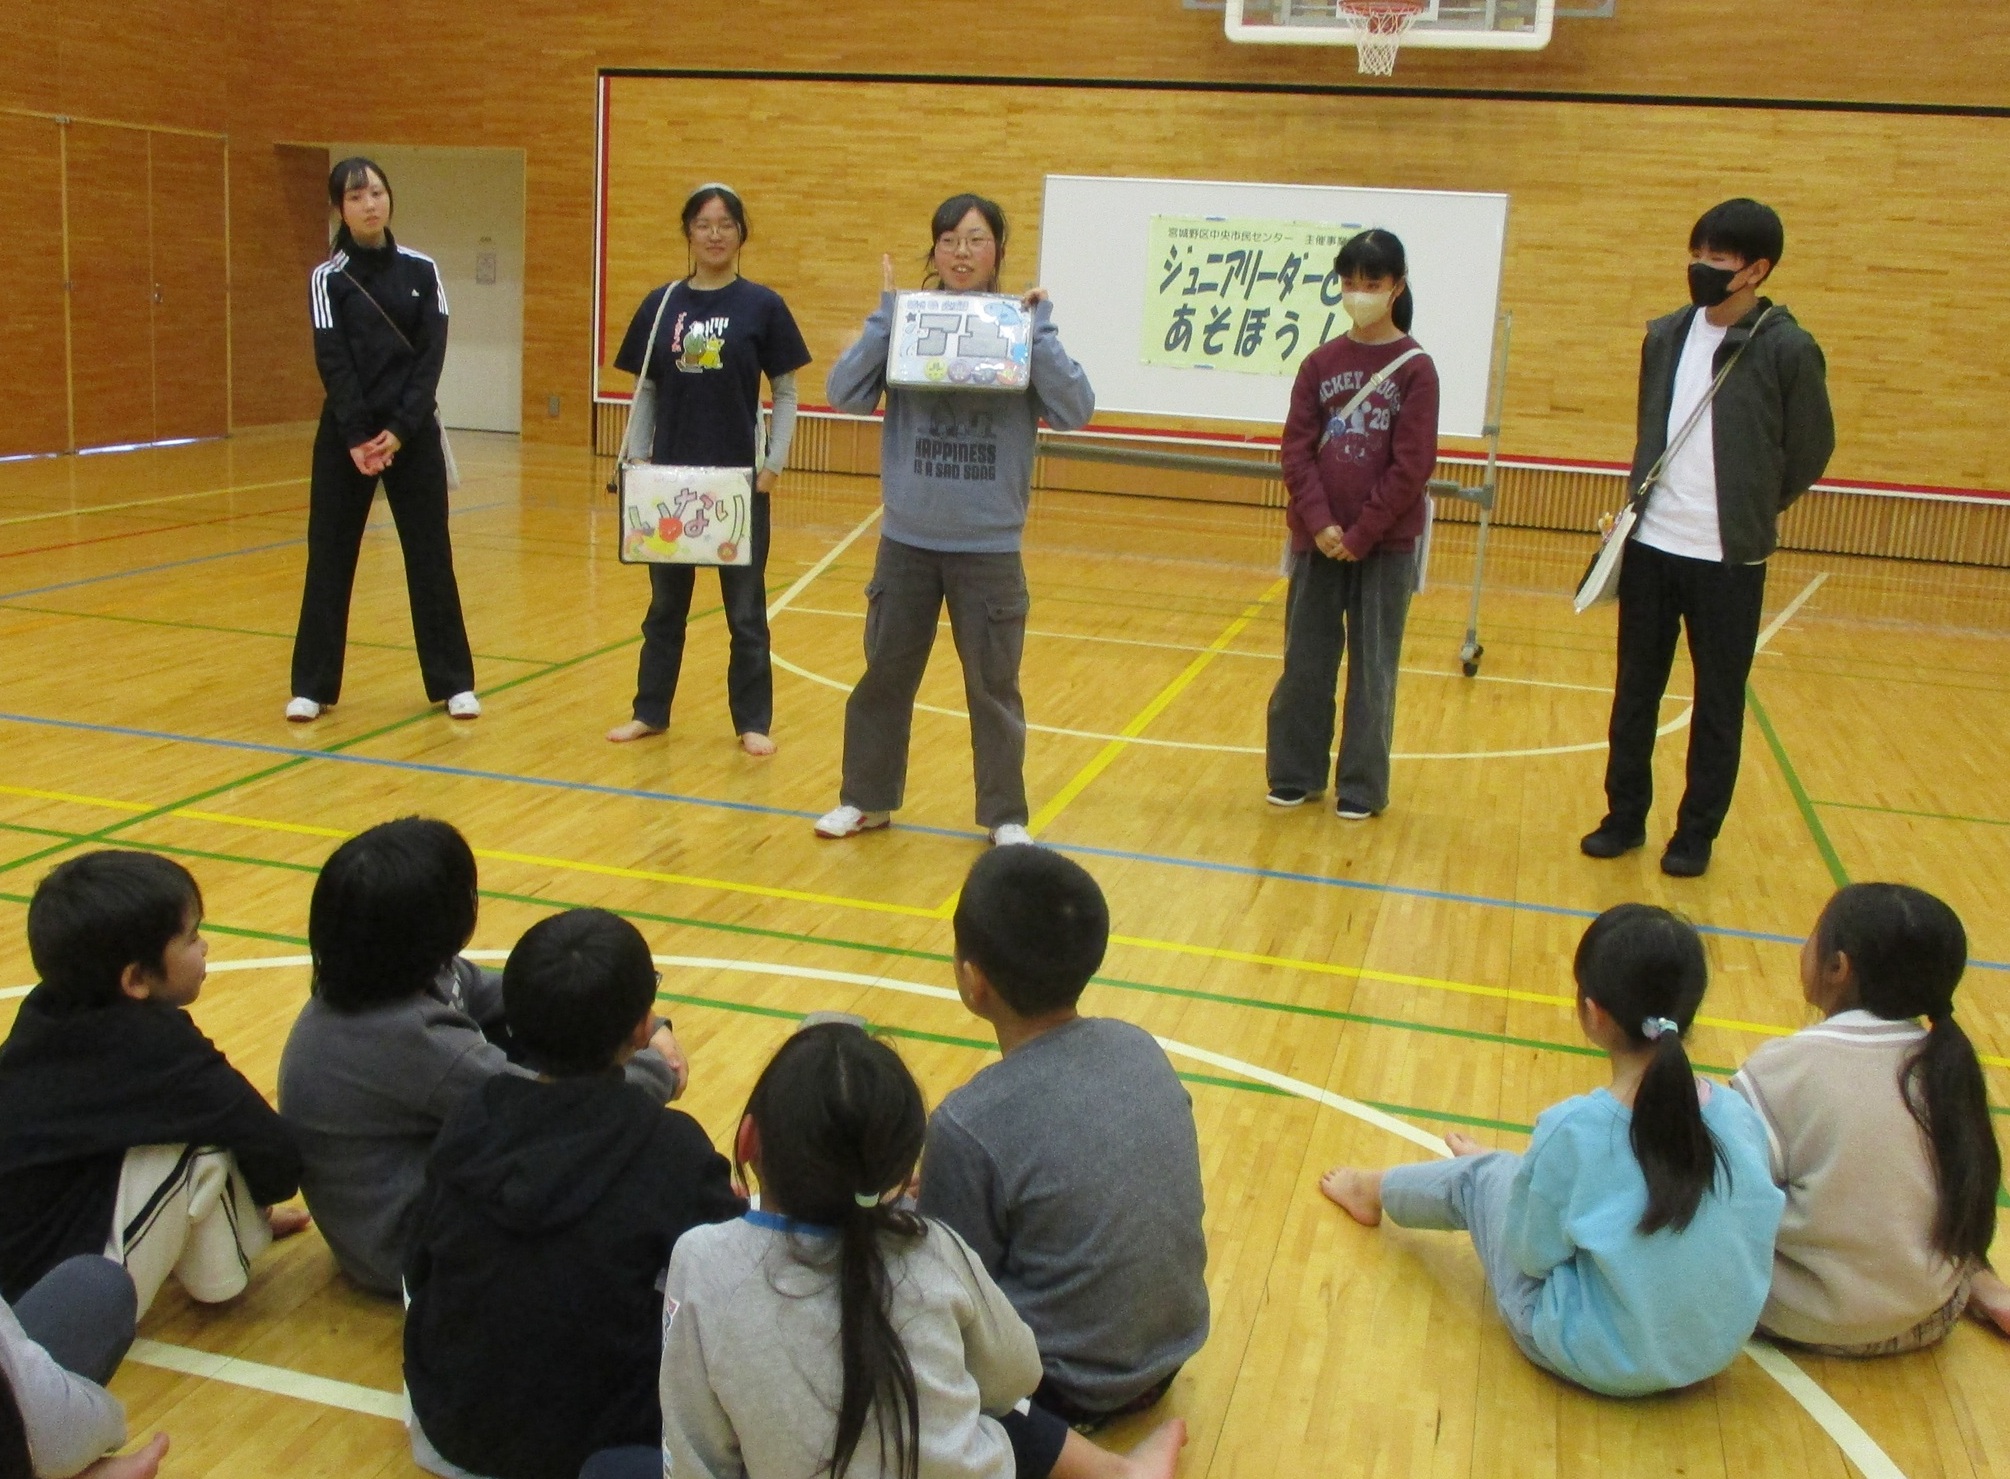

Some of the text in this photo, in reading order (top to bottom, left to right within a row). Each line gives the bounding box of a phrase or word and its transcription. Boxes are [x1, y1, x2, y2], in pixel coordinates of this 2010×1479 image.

[1167, 227, 1293, 243] 宮城野区中央市民センター
[915, 437, 996, 464] HAPPINESS
[914, 459, 922, 475] IS
[926, 461, 933, 477] A
[936, 462, 960, 480] SAD
